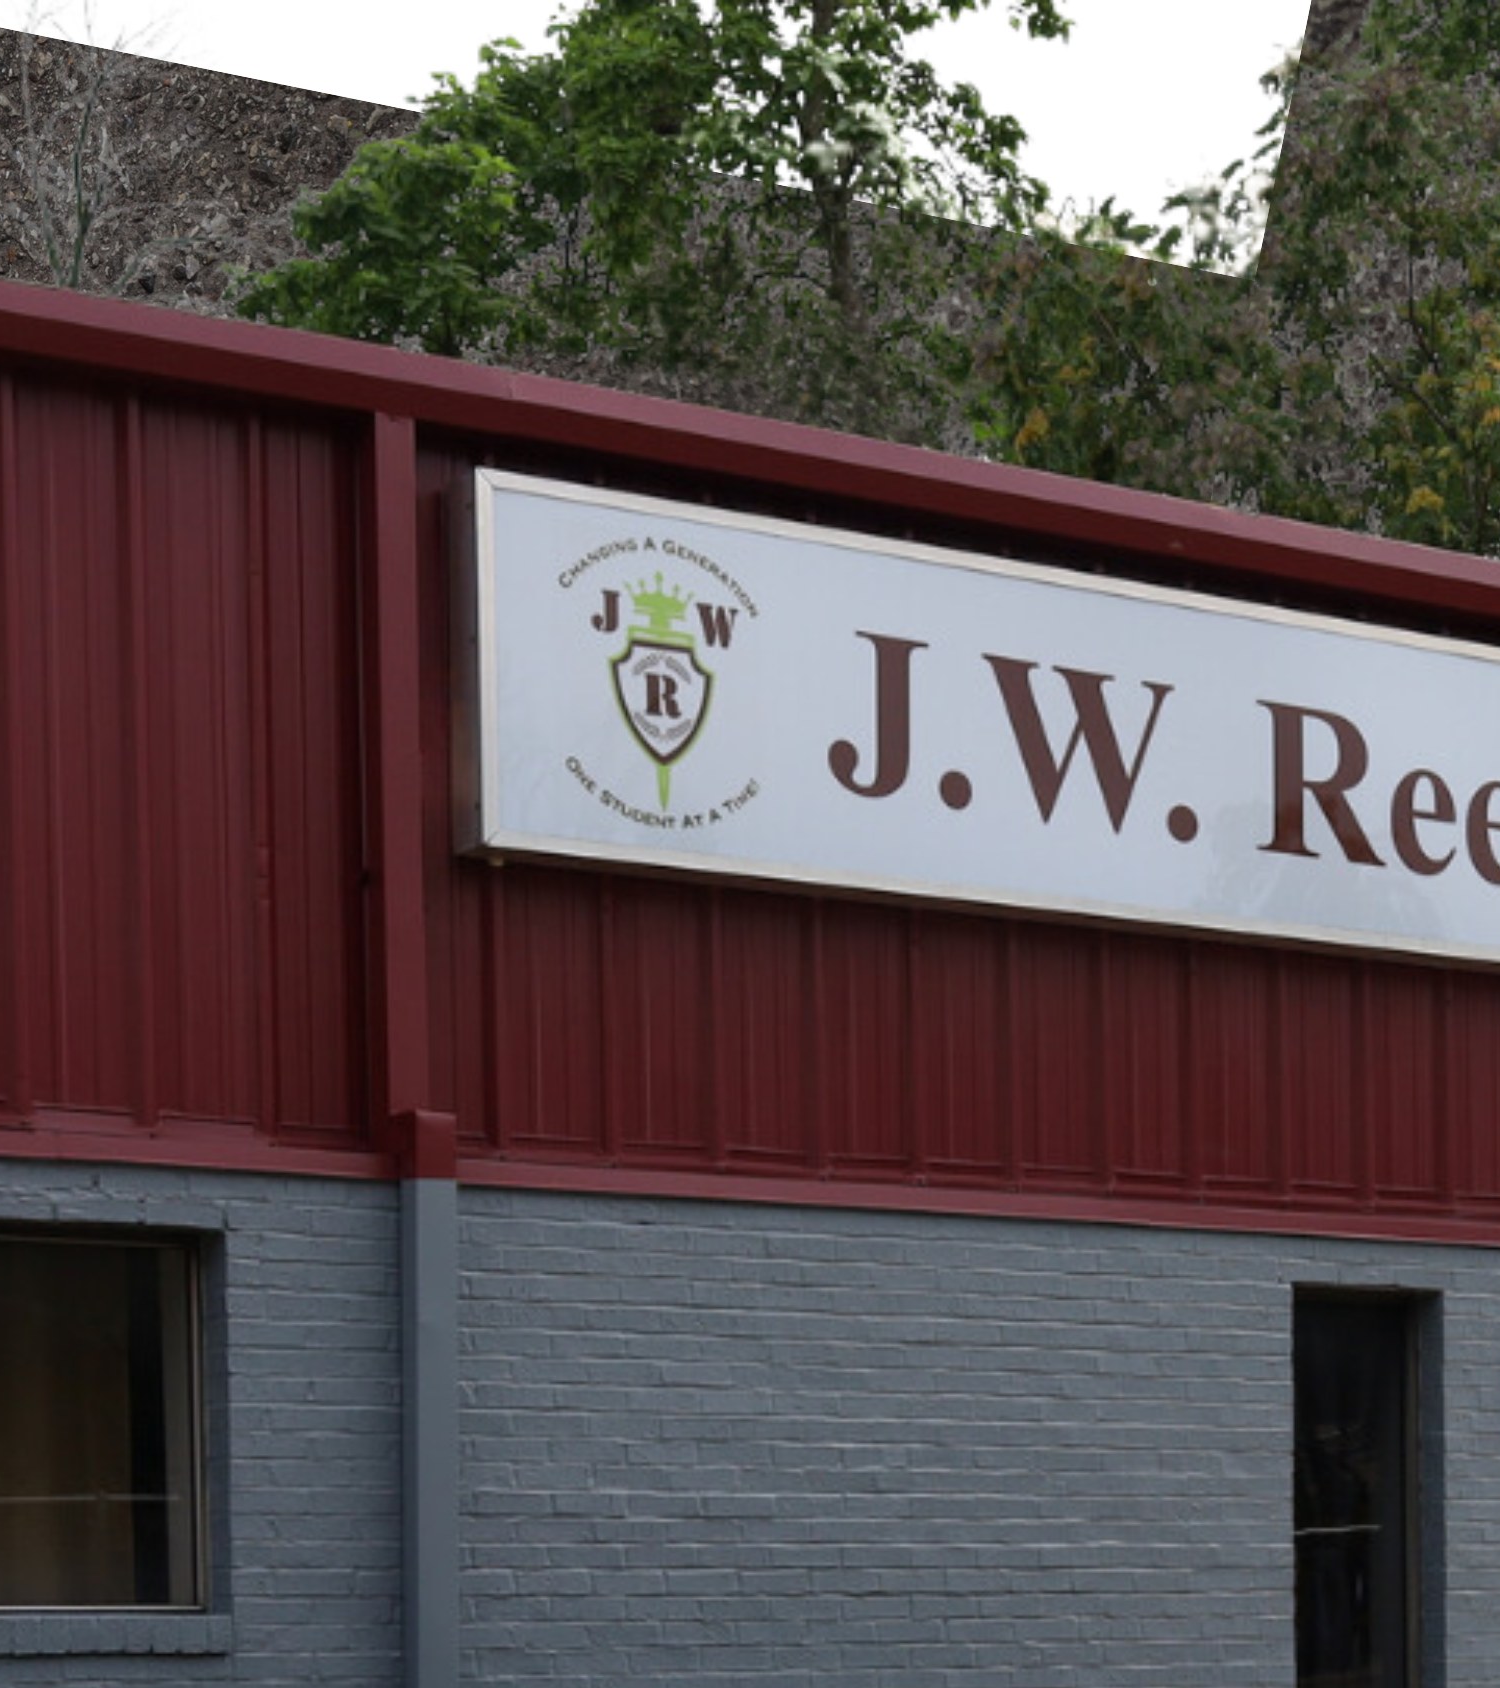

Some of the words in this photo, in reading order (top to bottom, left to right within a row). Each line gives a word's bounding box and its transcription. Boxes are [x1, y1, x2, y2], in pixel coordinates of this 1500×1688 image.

[558, 538, 638, 589] CHANGING
[644, 536, 657, 551] A
[661, 539, 760, 618] GENERATION
[591, 589, 620, 633] J
[696, 602, 739, 650] W
[645, 671, 682, 719] R
[826, 629, 1200, 844] J.W.
[600, 789, 676, 829] STUDENT
[682, 815, 704, 829] AT
[709, 808, 722, 823] A
